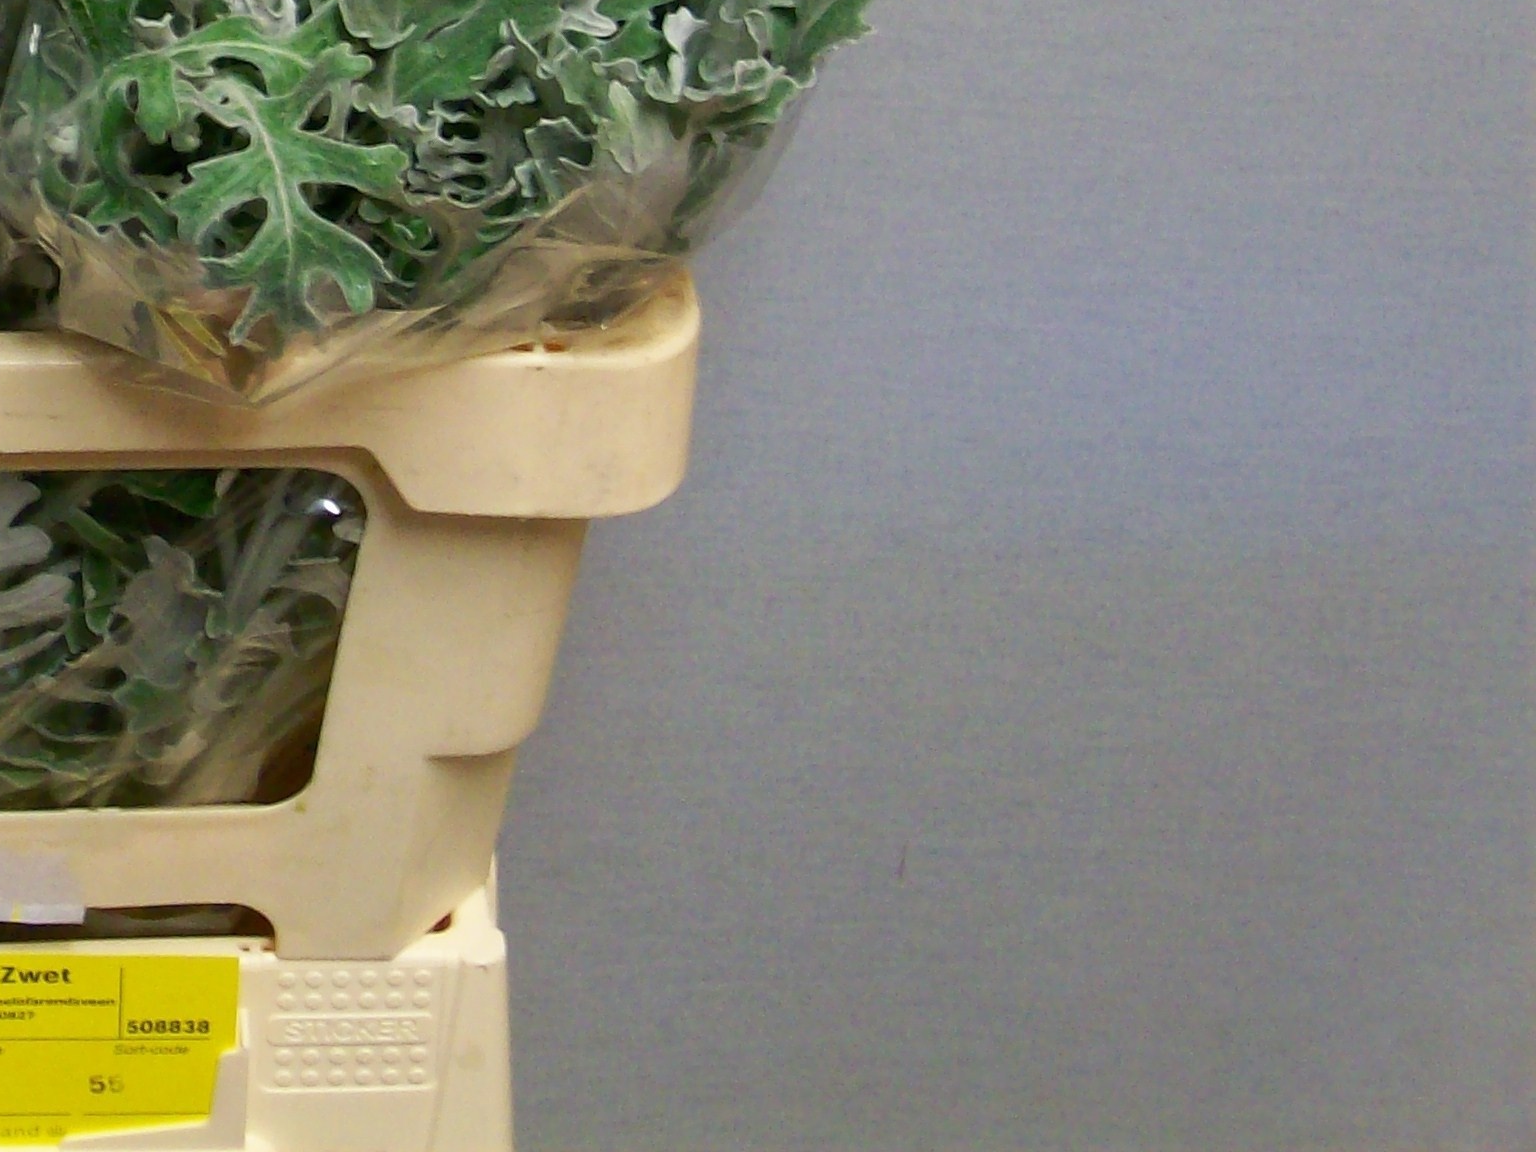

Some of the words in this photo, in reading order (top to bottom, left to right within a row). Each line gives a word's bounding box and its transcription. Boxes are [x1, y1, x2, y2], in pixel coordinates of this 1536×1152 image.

[0, 965, 72, 984] Zwet
[127, 1019, 210, 1035] 508838
[284, 1019, 420, 1042] STICKER
